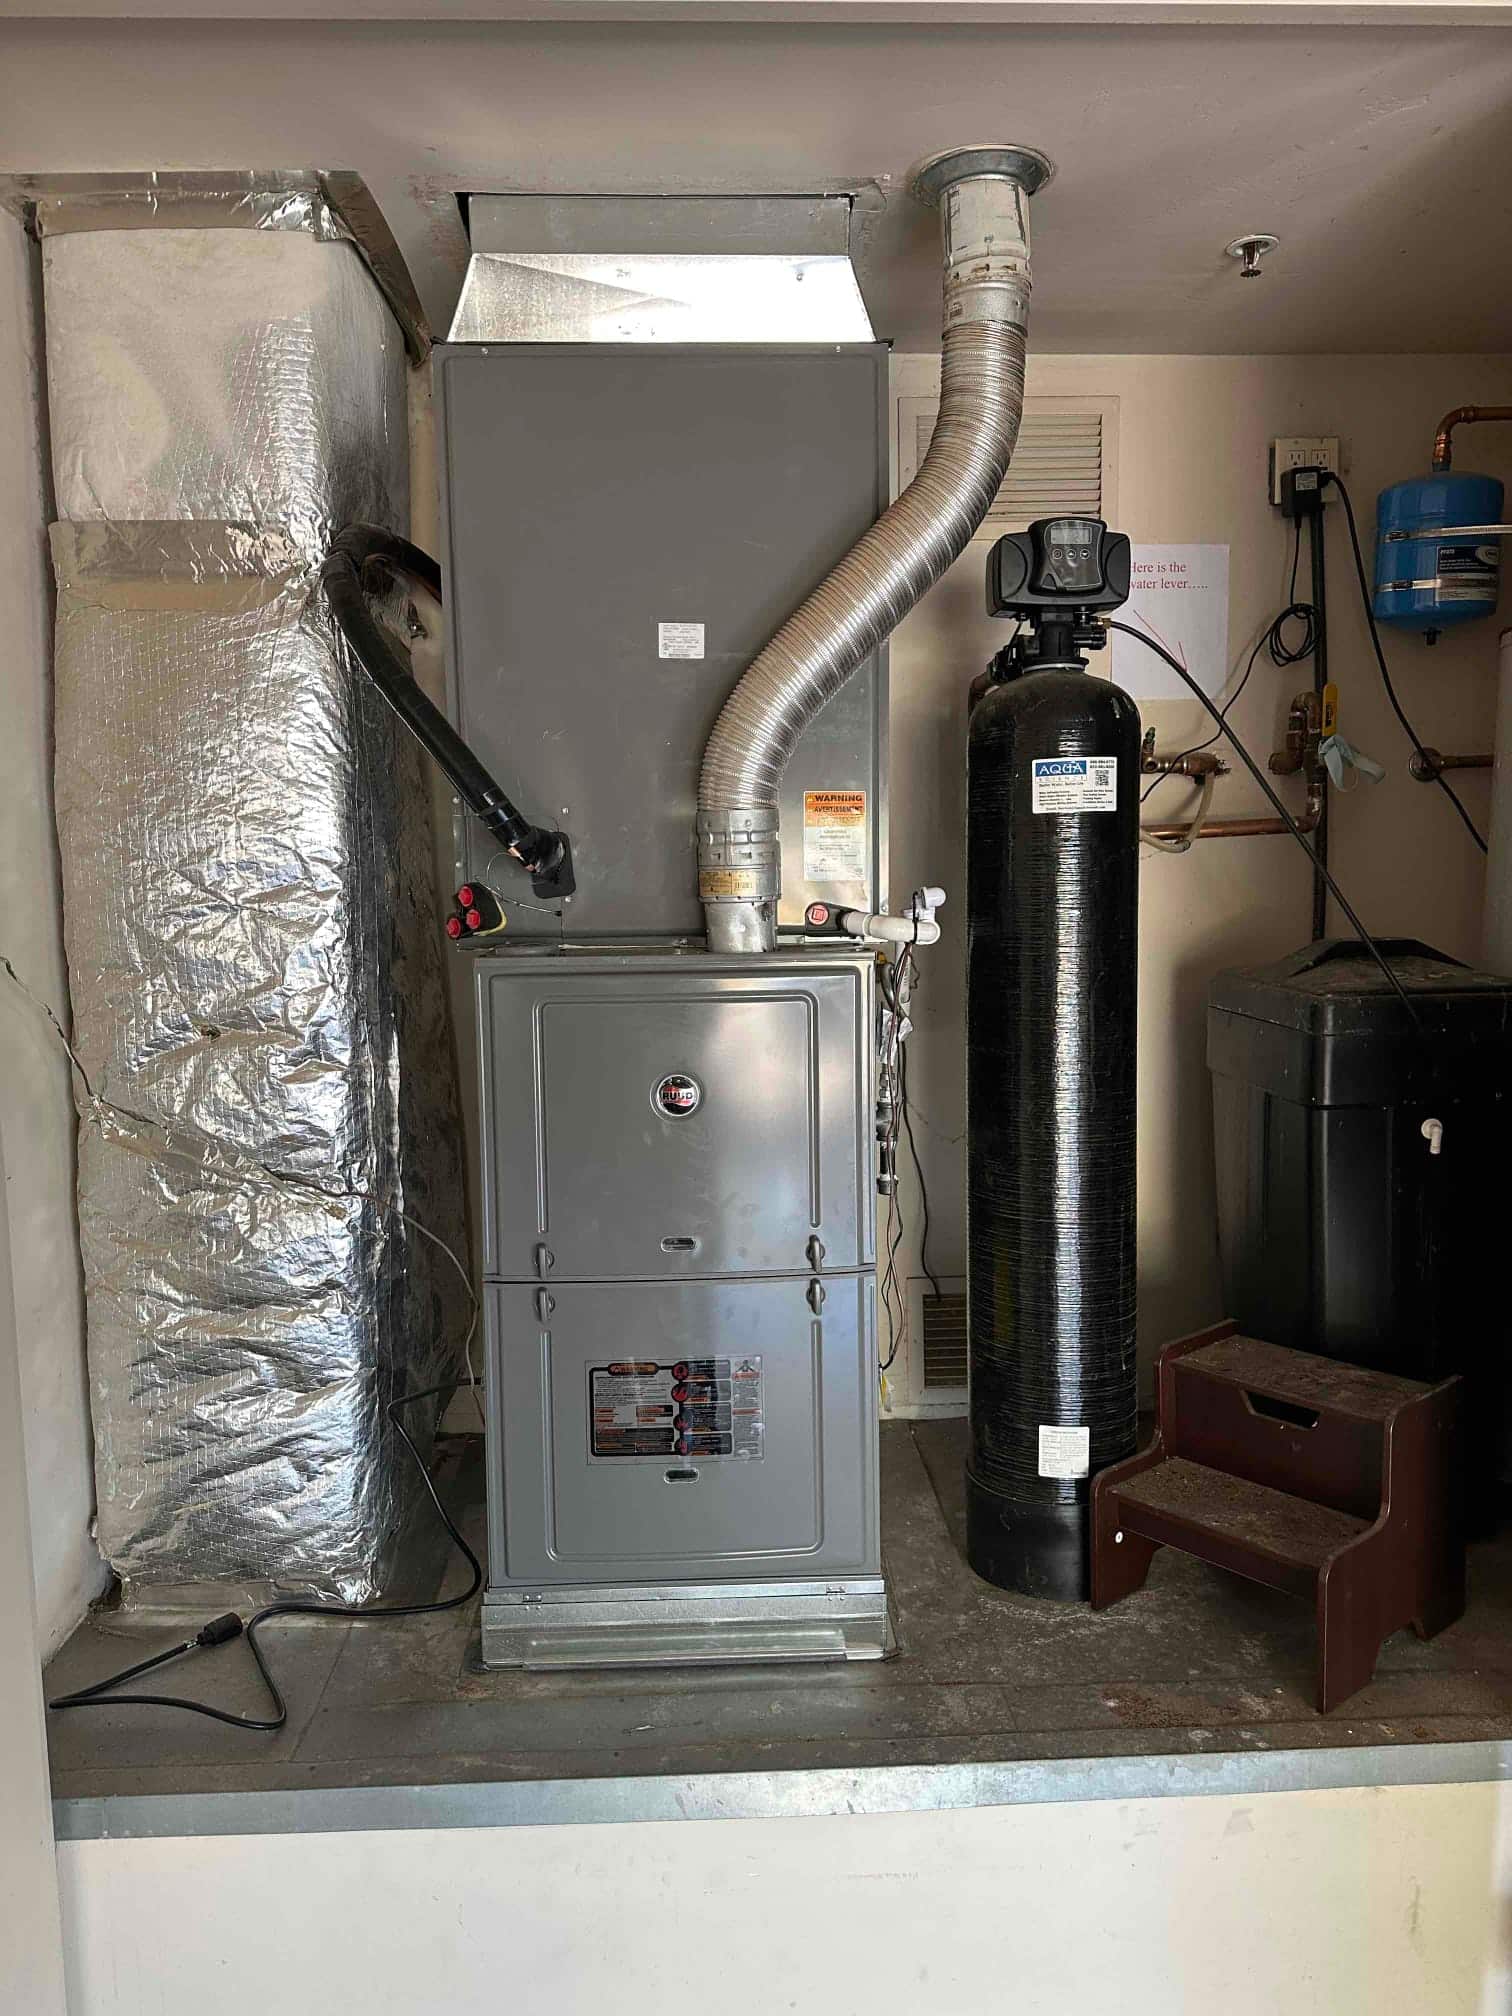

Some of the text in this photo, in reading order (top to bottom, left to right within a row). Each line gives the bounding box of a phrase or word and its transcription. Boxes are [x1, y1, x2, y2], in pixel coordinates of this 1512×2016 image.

[1157, 562, 1166, 573] is
[1169, 562, 1187, 573] the
[1039, 762, 1084, 775] AQUA
[815, 794, 863, 802] WARNING
